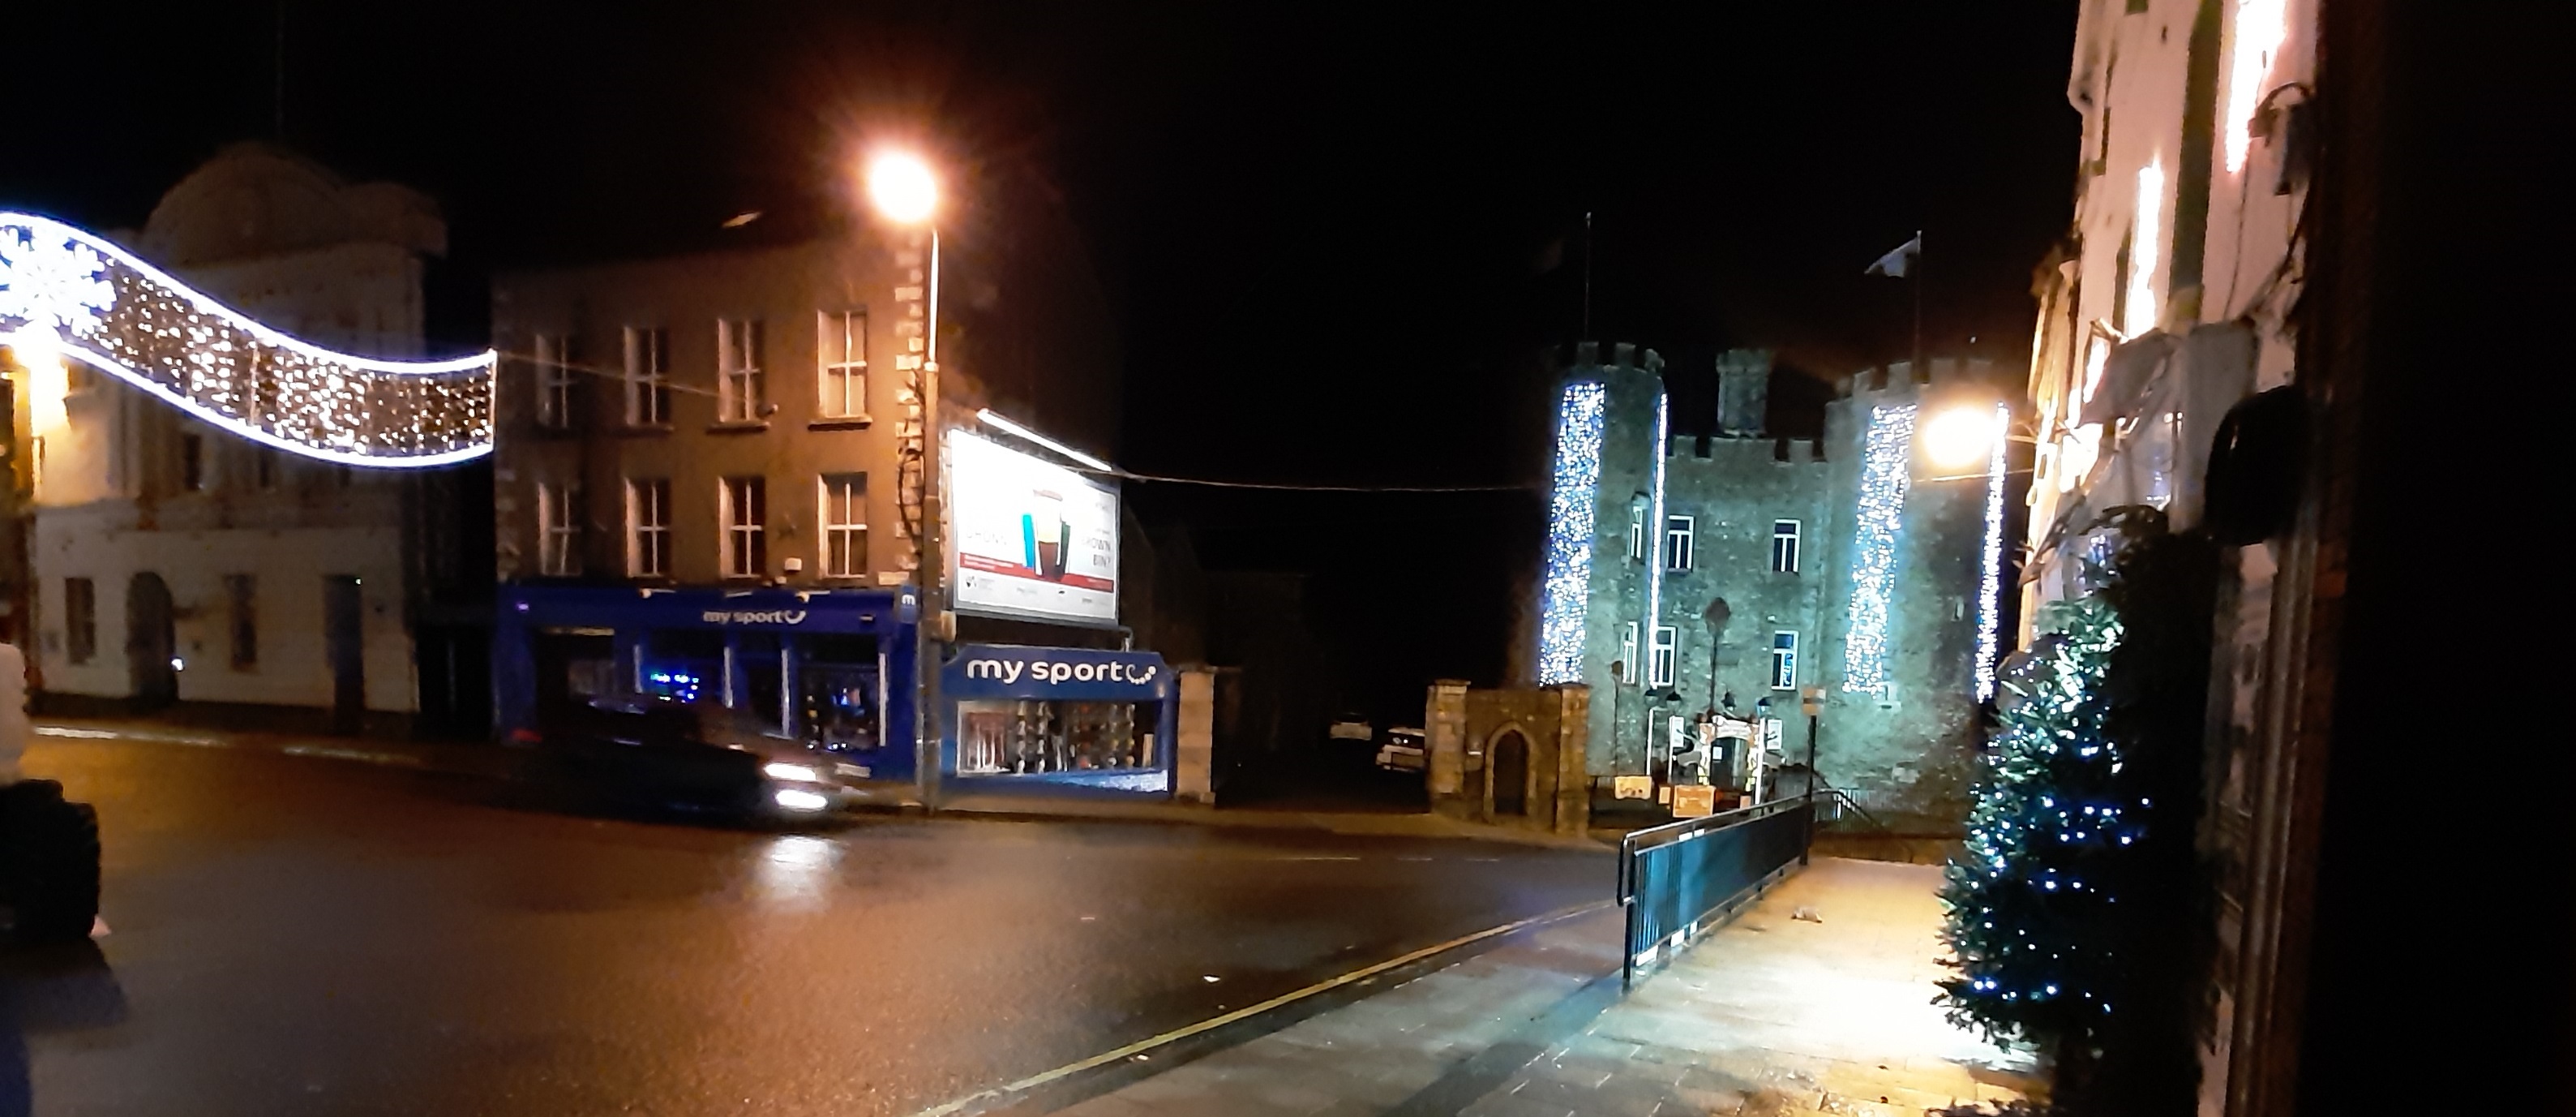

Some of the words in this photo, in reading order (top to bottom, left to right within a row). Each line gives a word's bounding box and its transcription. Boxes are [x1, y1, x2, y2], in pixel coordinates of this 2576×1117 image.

[703, 611, 730, 625] my
[733, 610, 782, 625] sport
[967, 659, 1024, 684] my
[1031, 660, 1123, 685] sport
